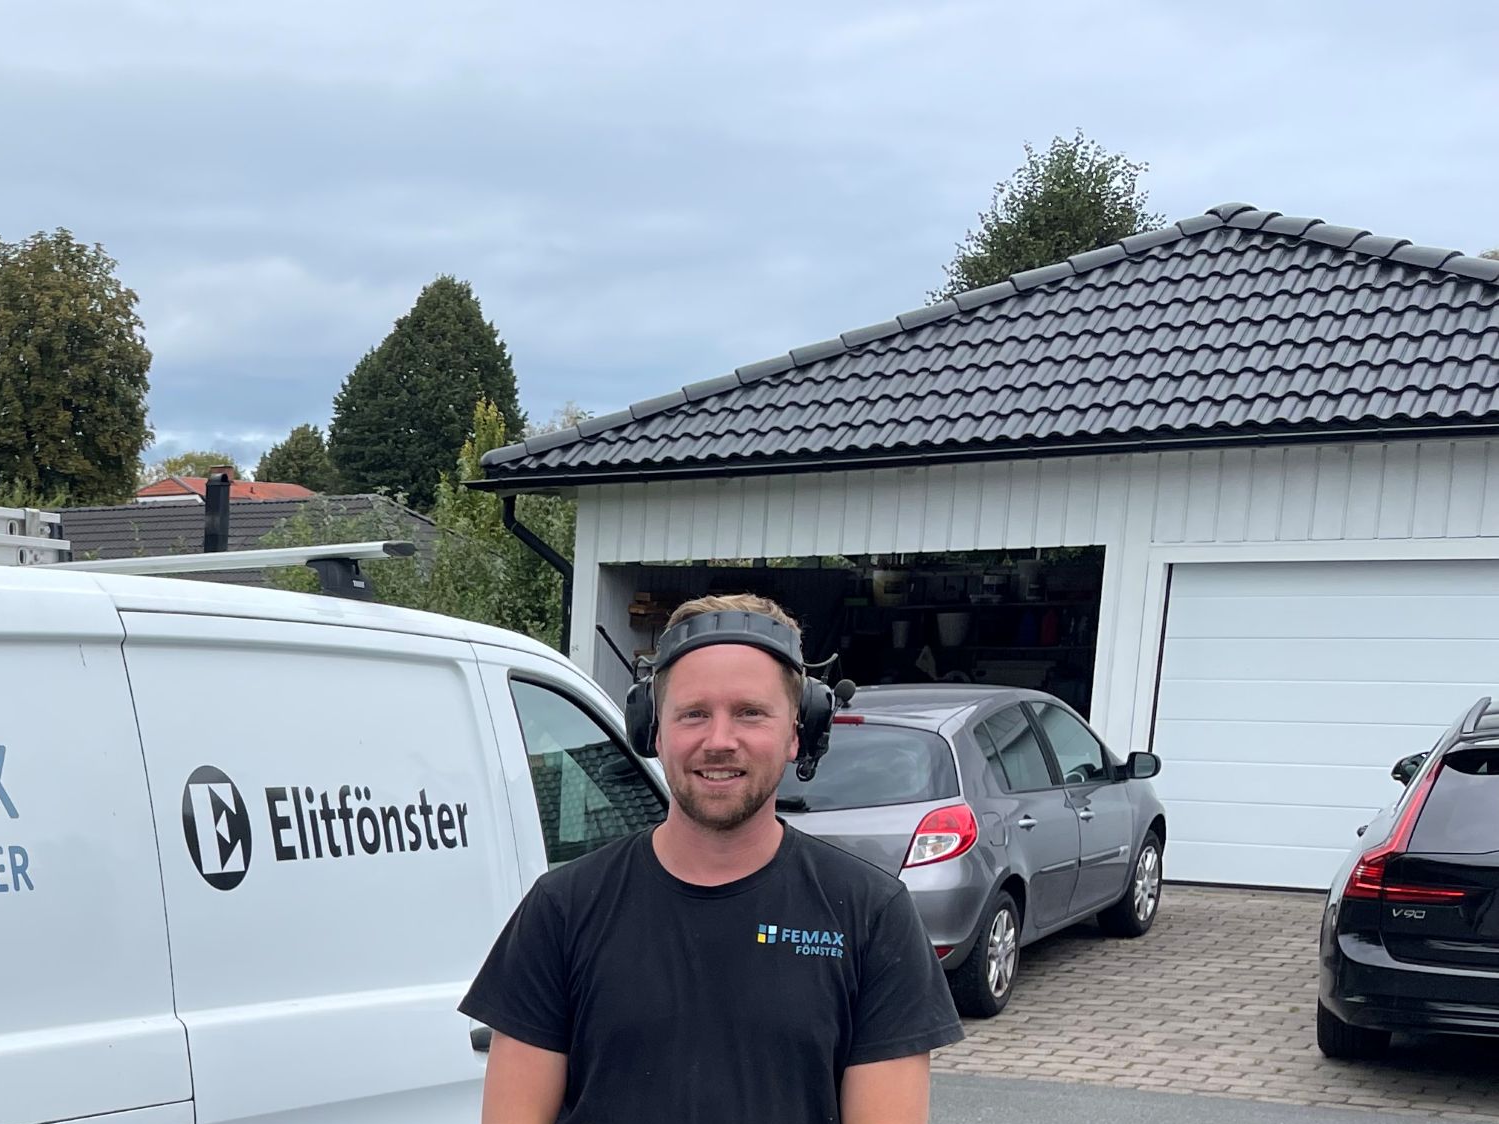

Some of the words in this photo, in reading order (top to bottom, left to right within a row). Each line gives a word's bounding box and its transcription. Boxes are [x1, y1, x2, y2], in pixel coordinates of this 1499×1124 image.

[264, 784, 469, 862] Elitfönster
[781, 928, 845, 947] FEMAX
[795, 945, 844, 959] FÖNSTER
